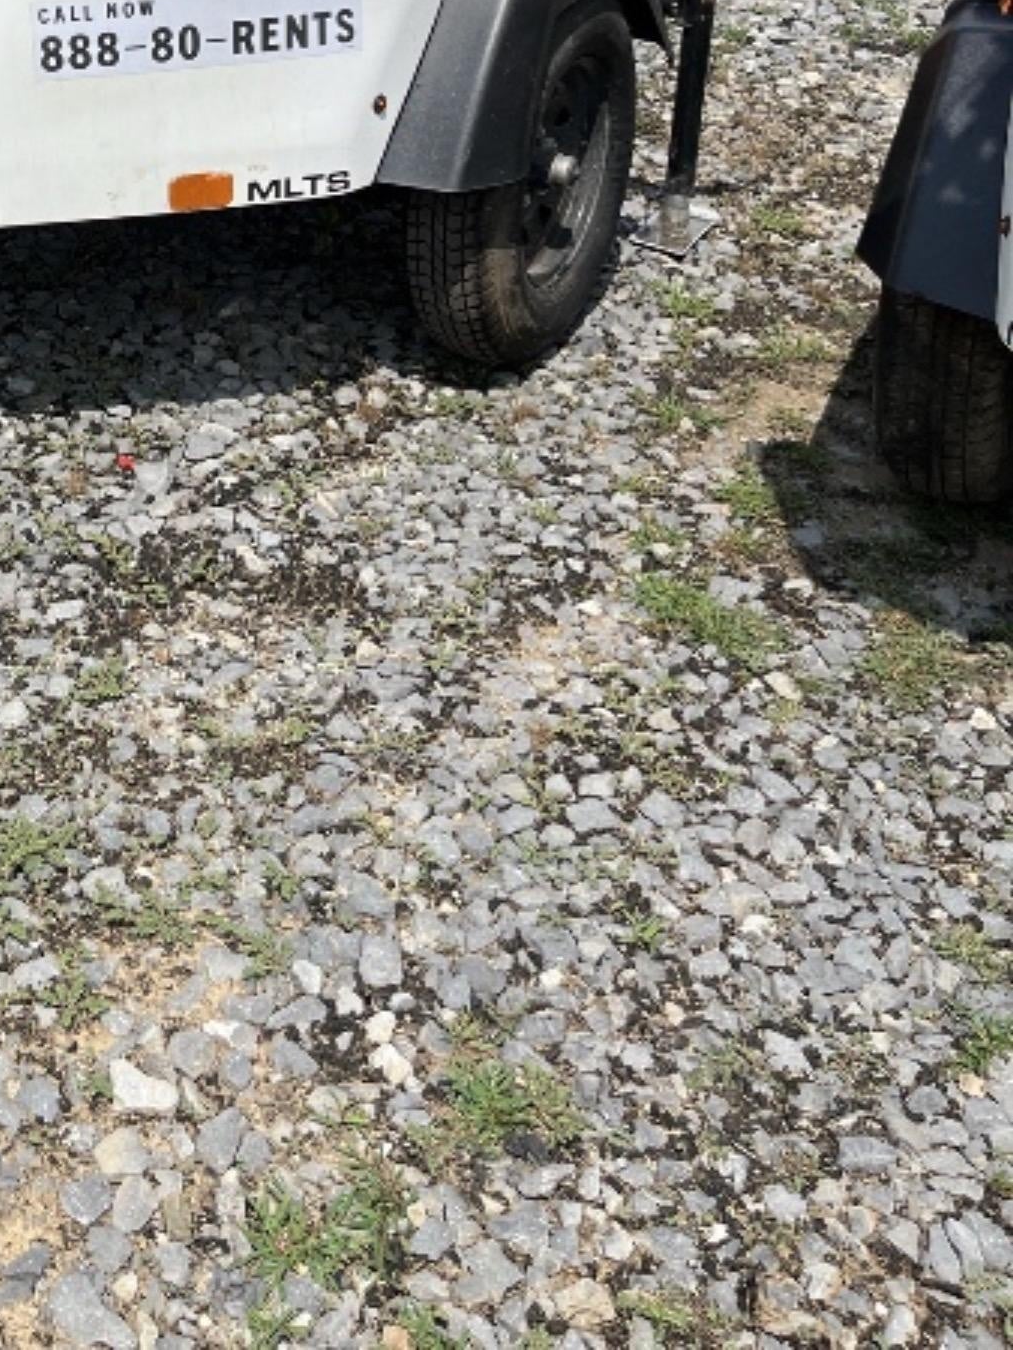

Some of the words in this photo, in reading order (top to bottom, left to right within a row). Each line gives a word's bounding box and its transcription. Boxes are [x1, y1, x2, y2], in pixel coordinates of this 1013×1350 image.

[37, 6, 94, 25] CALL
[106, 0, 155, 20] NOW
[39, 8, 355, 72] 888-80-RENTS
[246, 170, 352, 202] MLTS
